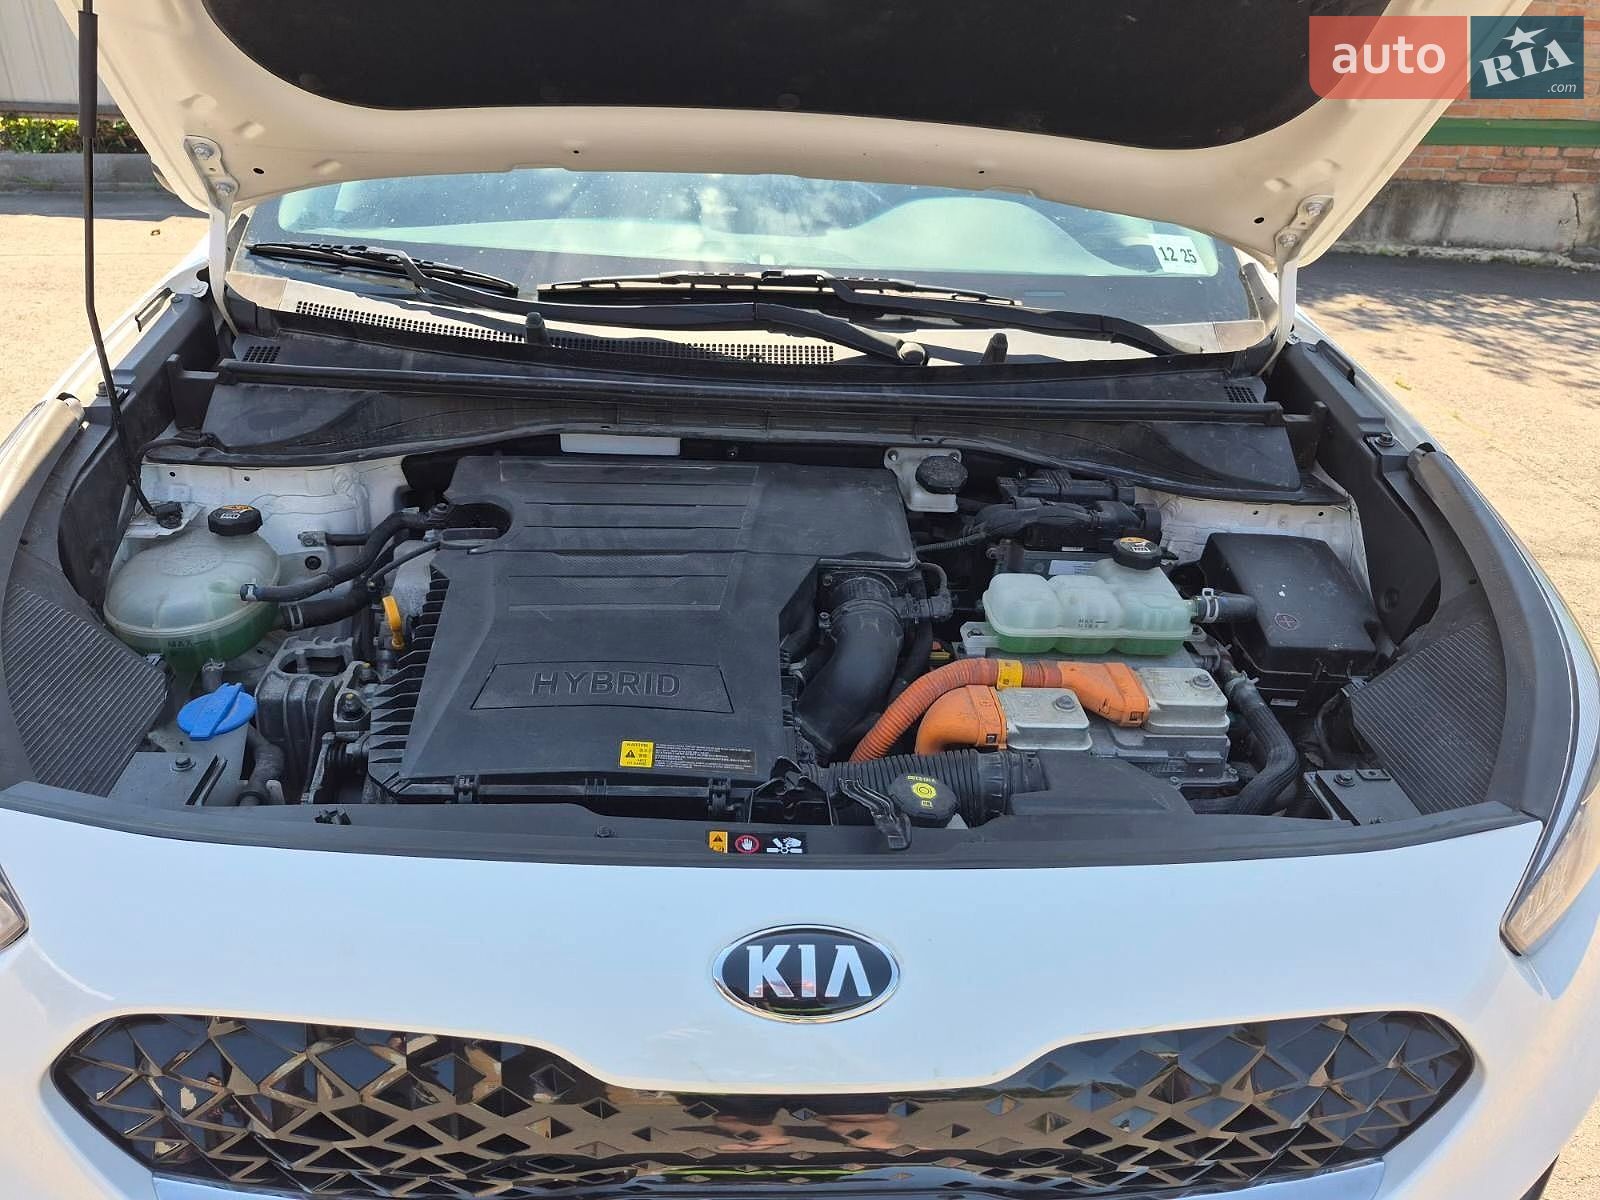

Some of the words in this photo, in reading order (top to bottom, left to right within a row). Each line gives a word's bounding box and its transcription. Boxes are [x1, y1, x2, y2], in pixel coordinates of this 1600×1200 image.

[1158, 246, 1178, 262] 12
[1180, 248, 1197, 264] 25
[531, 670, 681, 698] HYBRID
[746, 944, 873, 998] KIA
